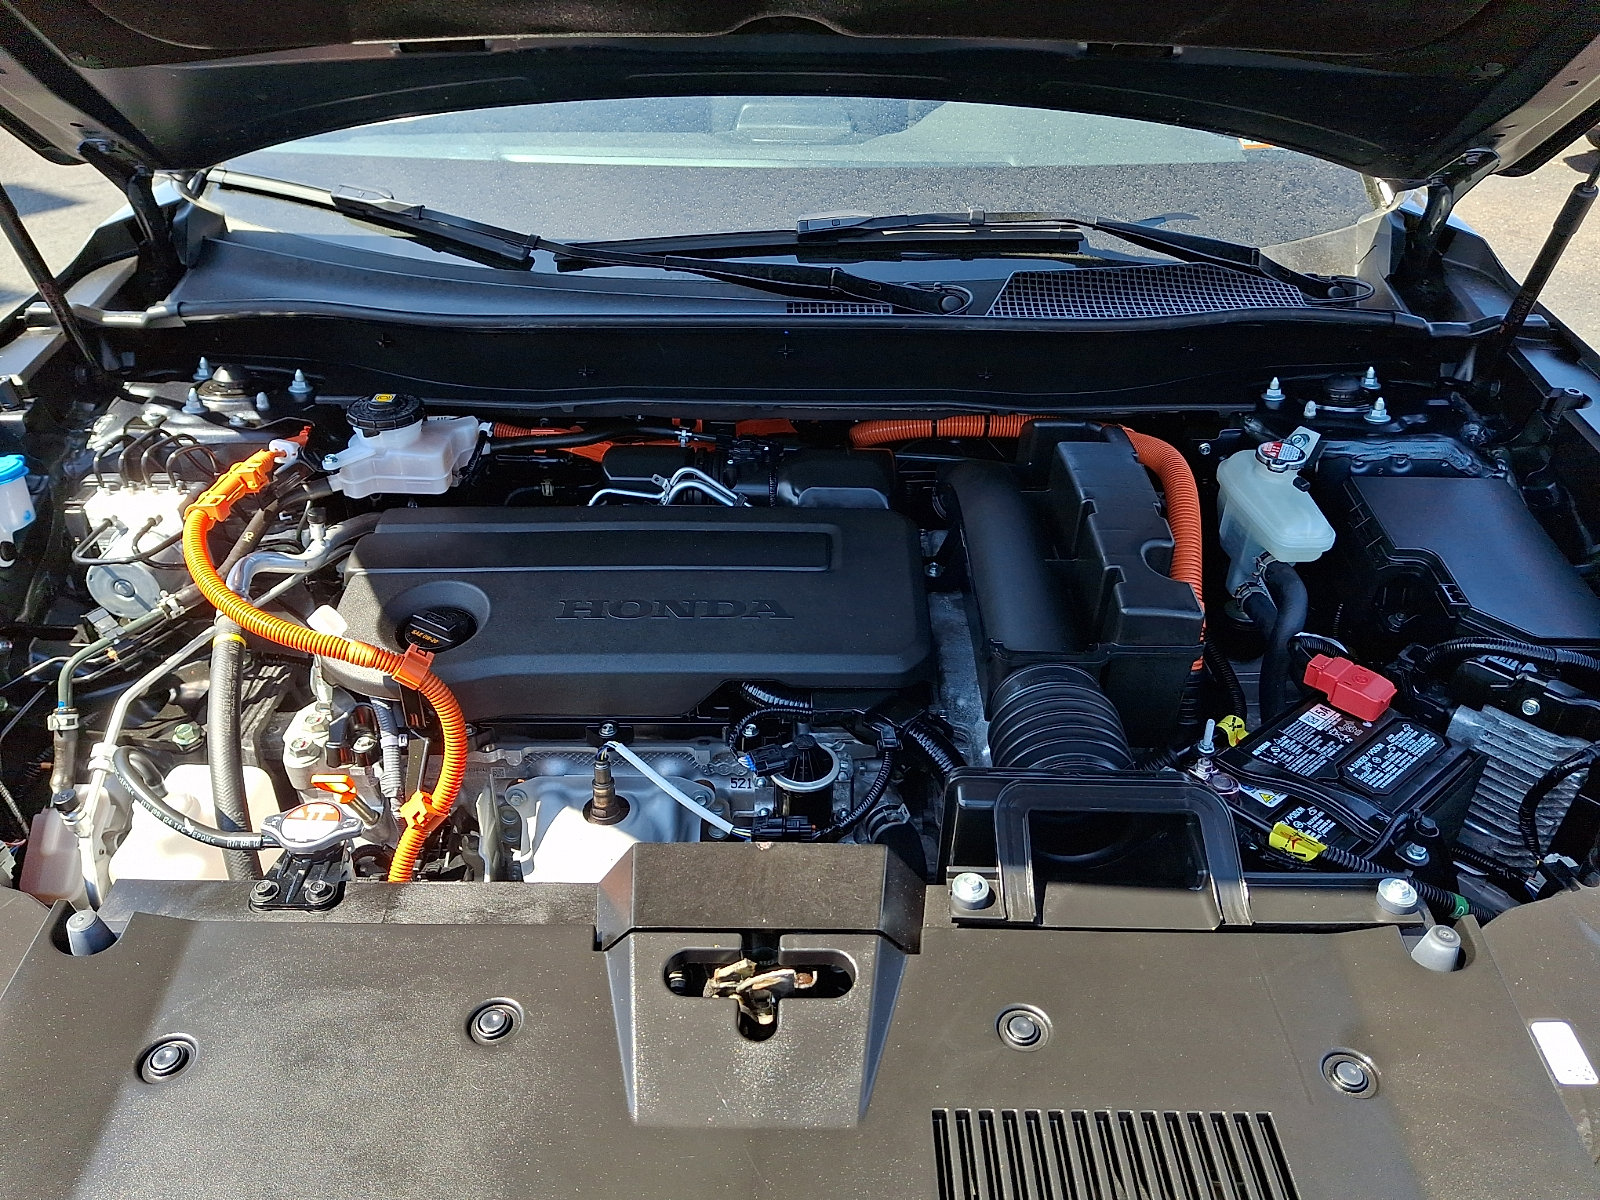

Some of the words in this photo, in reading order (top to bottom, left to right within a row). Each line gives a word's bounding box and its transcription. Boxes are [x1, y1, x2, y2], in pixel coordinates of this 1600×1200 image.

[554, 599, 794, 620] HONDA
[411, 629, 424, 638] SAE
[730, 777, 752, 789] 521
